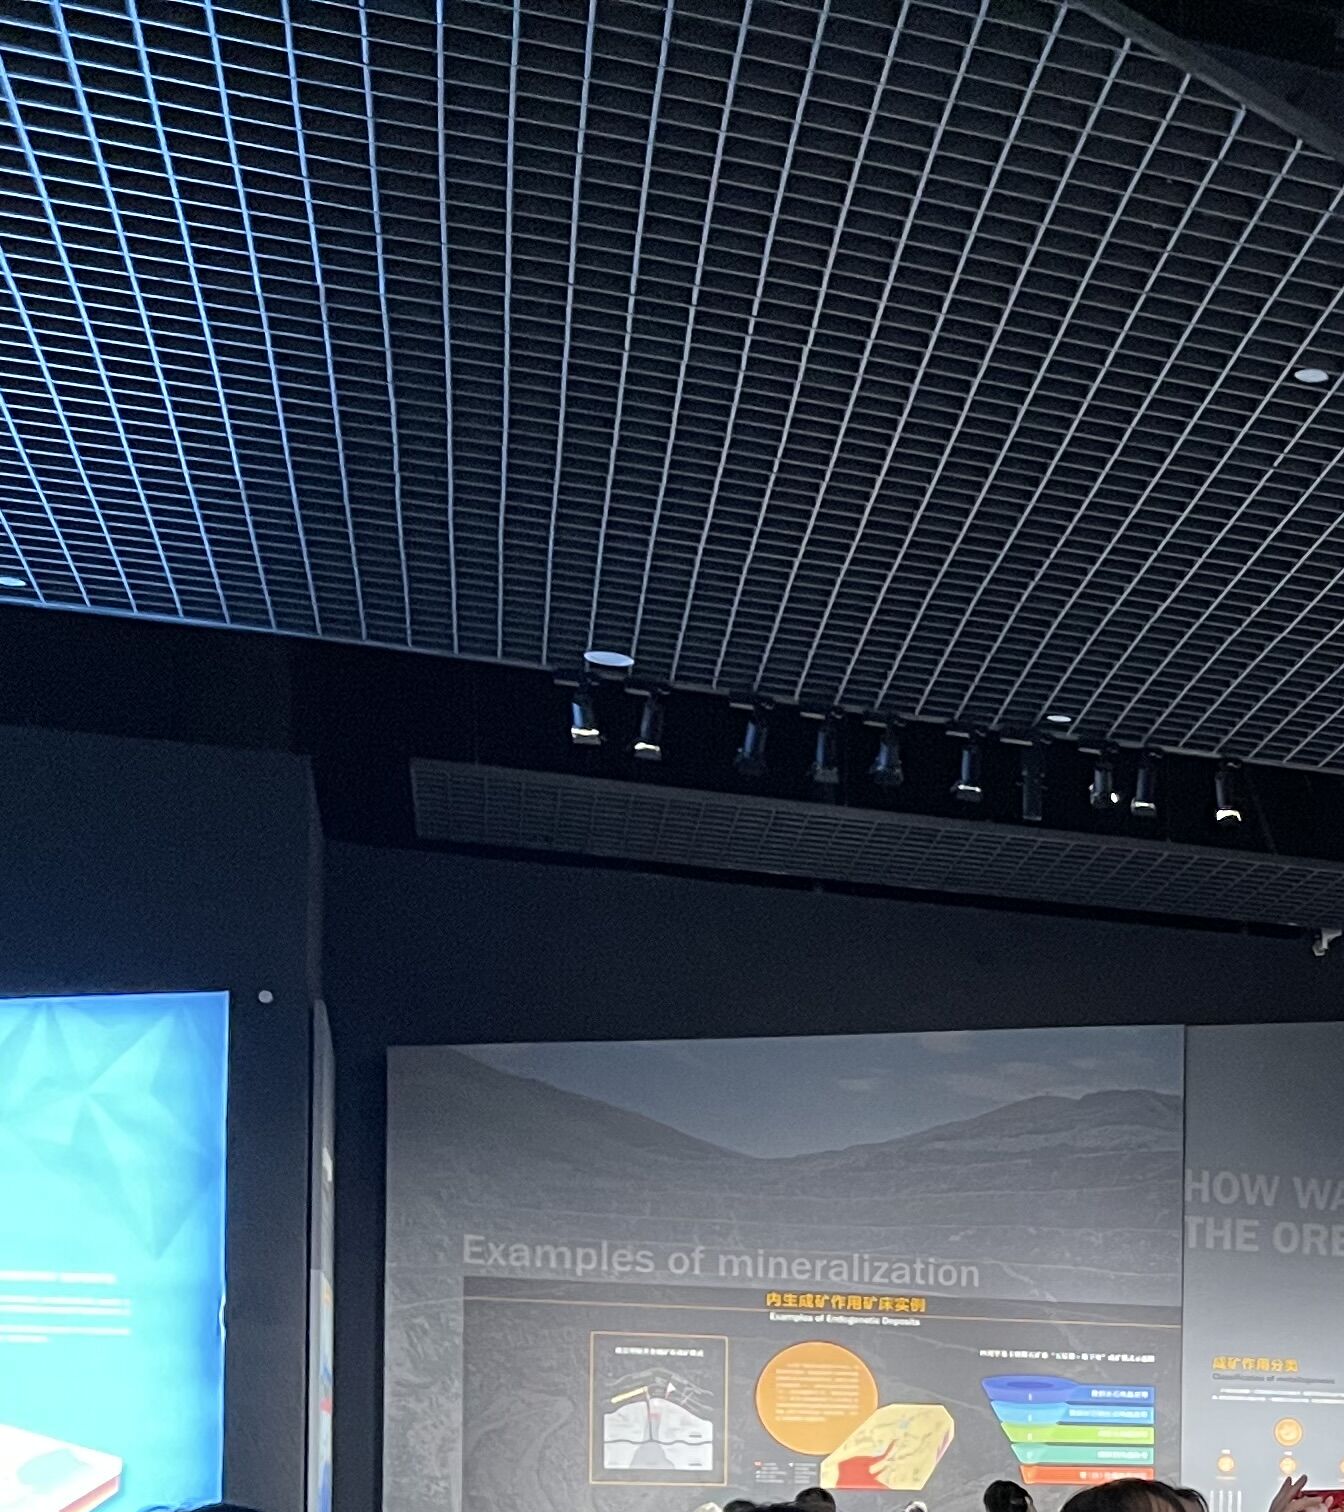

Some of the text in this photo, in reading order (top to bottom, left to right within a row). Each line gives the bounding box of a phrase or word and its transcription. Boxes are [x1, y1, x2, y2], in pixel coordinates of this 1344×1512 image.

[1185, 1168, 1281, 1206] HOW
[1184, 1215, 1260, 1252] THE
[463, 1233, 980, 1288] Examples of mineralization
